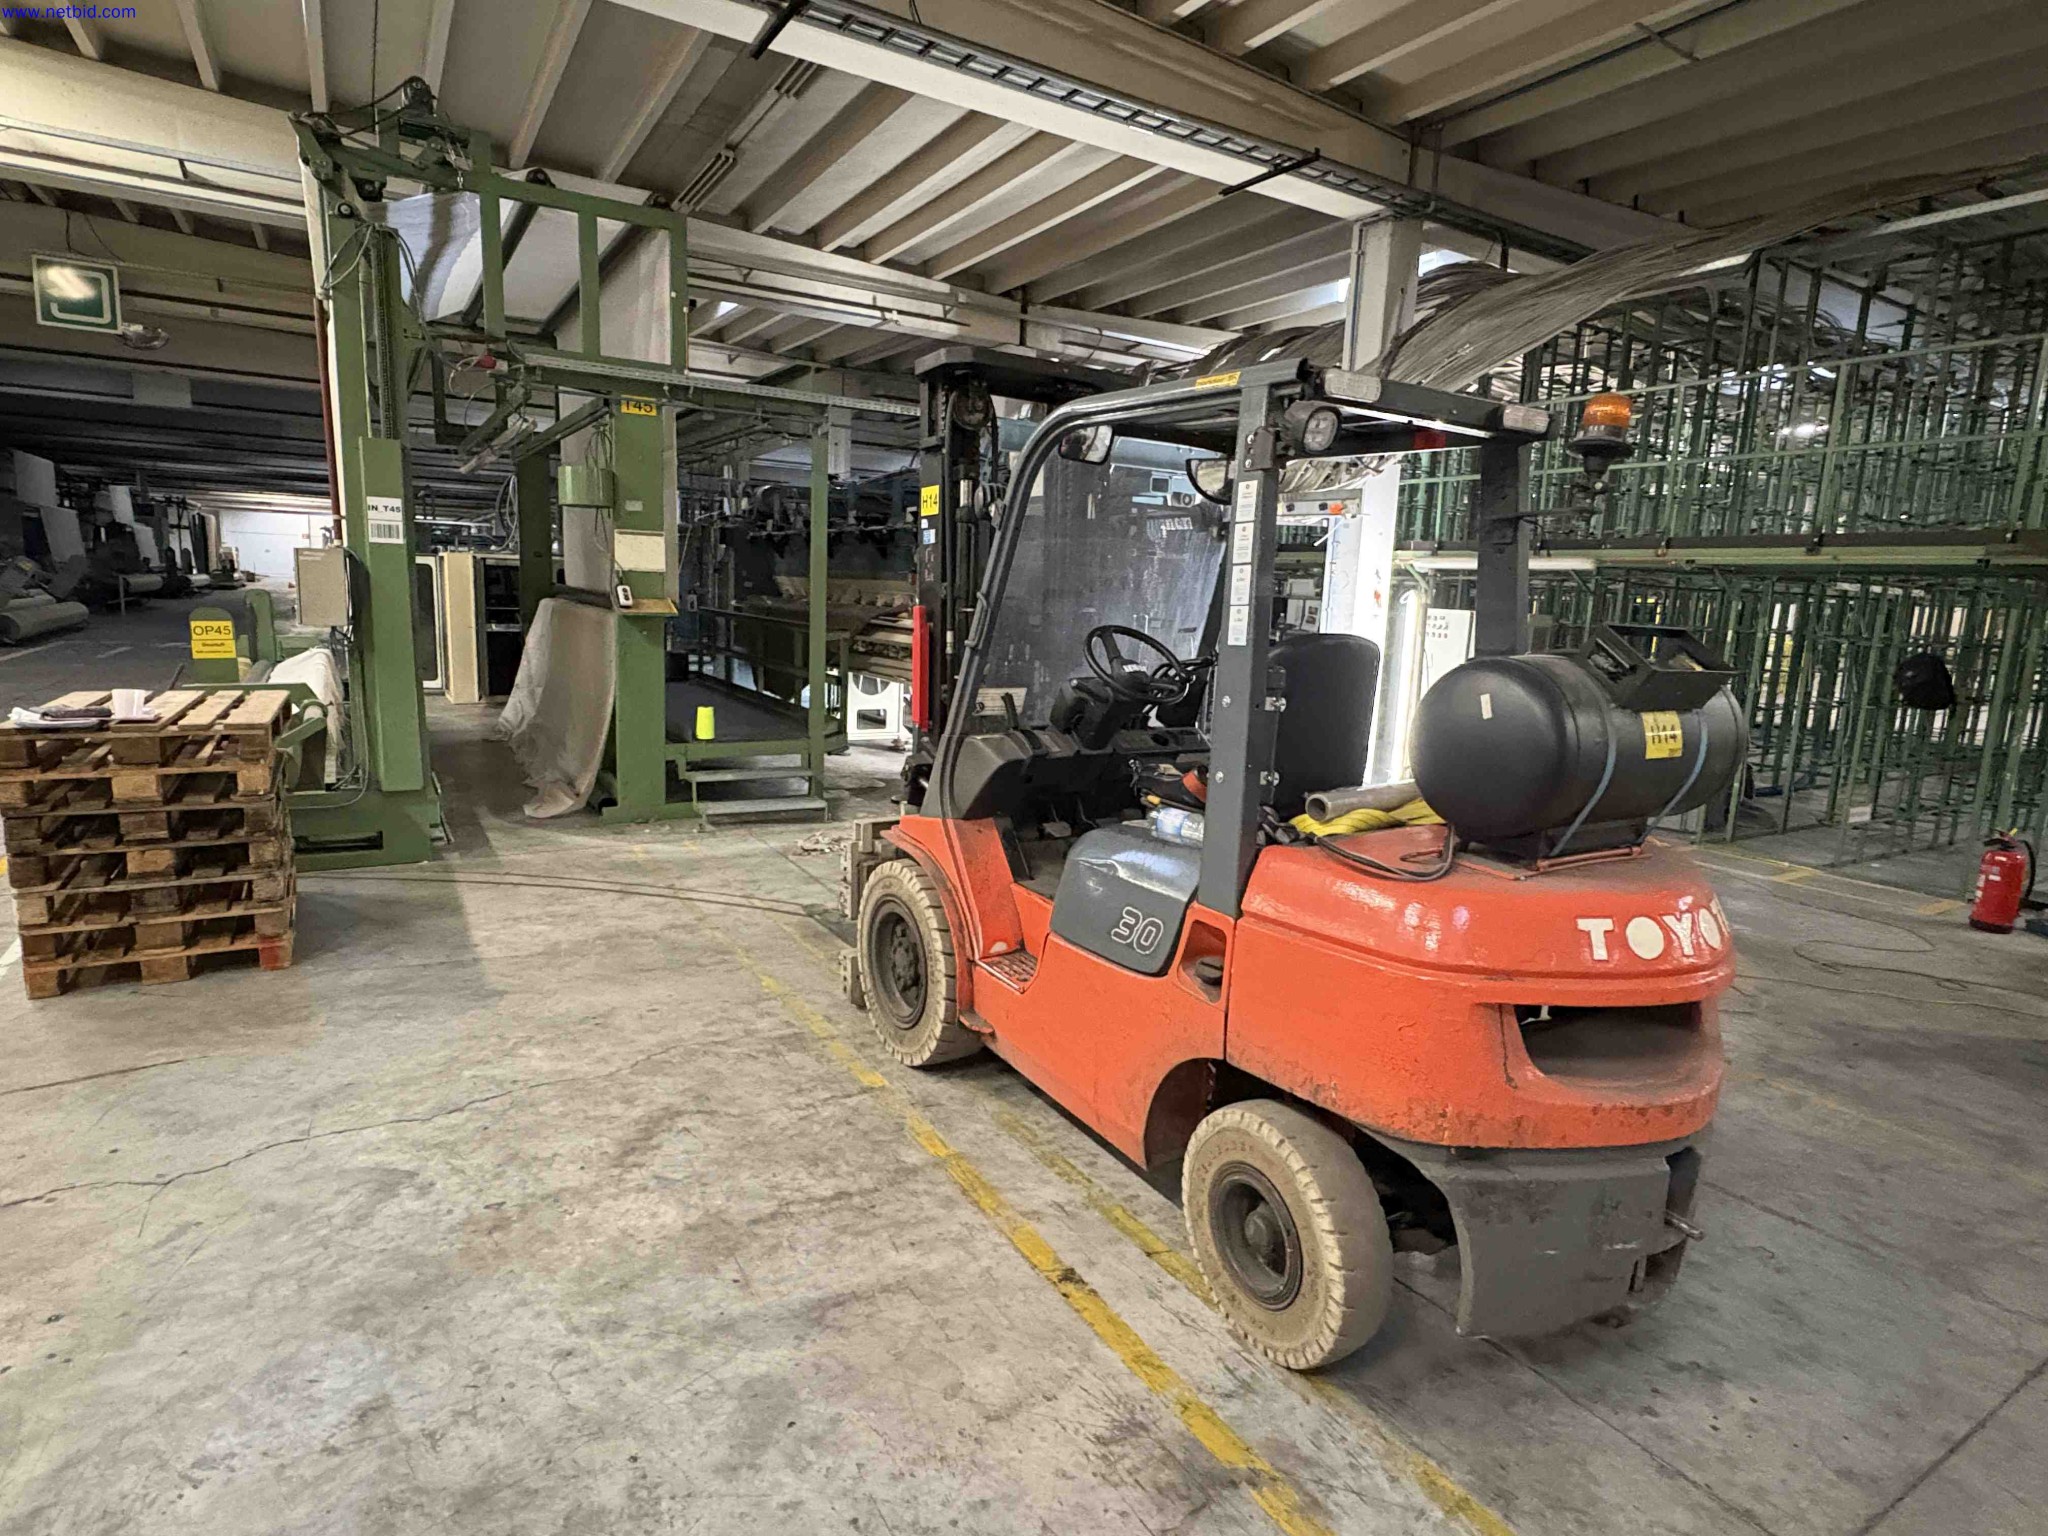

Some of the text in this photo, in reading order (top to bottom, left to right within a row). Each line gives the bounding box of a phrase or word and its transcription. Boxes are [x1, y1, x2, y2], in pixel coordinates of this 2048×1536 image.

[922, 492, 938, 509] H14
[193, 625, 232, 636] OP45
[1111, 906, 1164, 955] 30
[1576, 893, 1731, 961] TOYO
